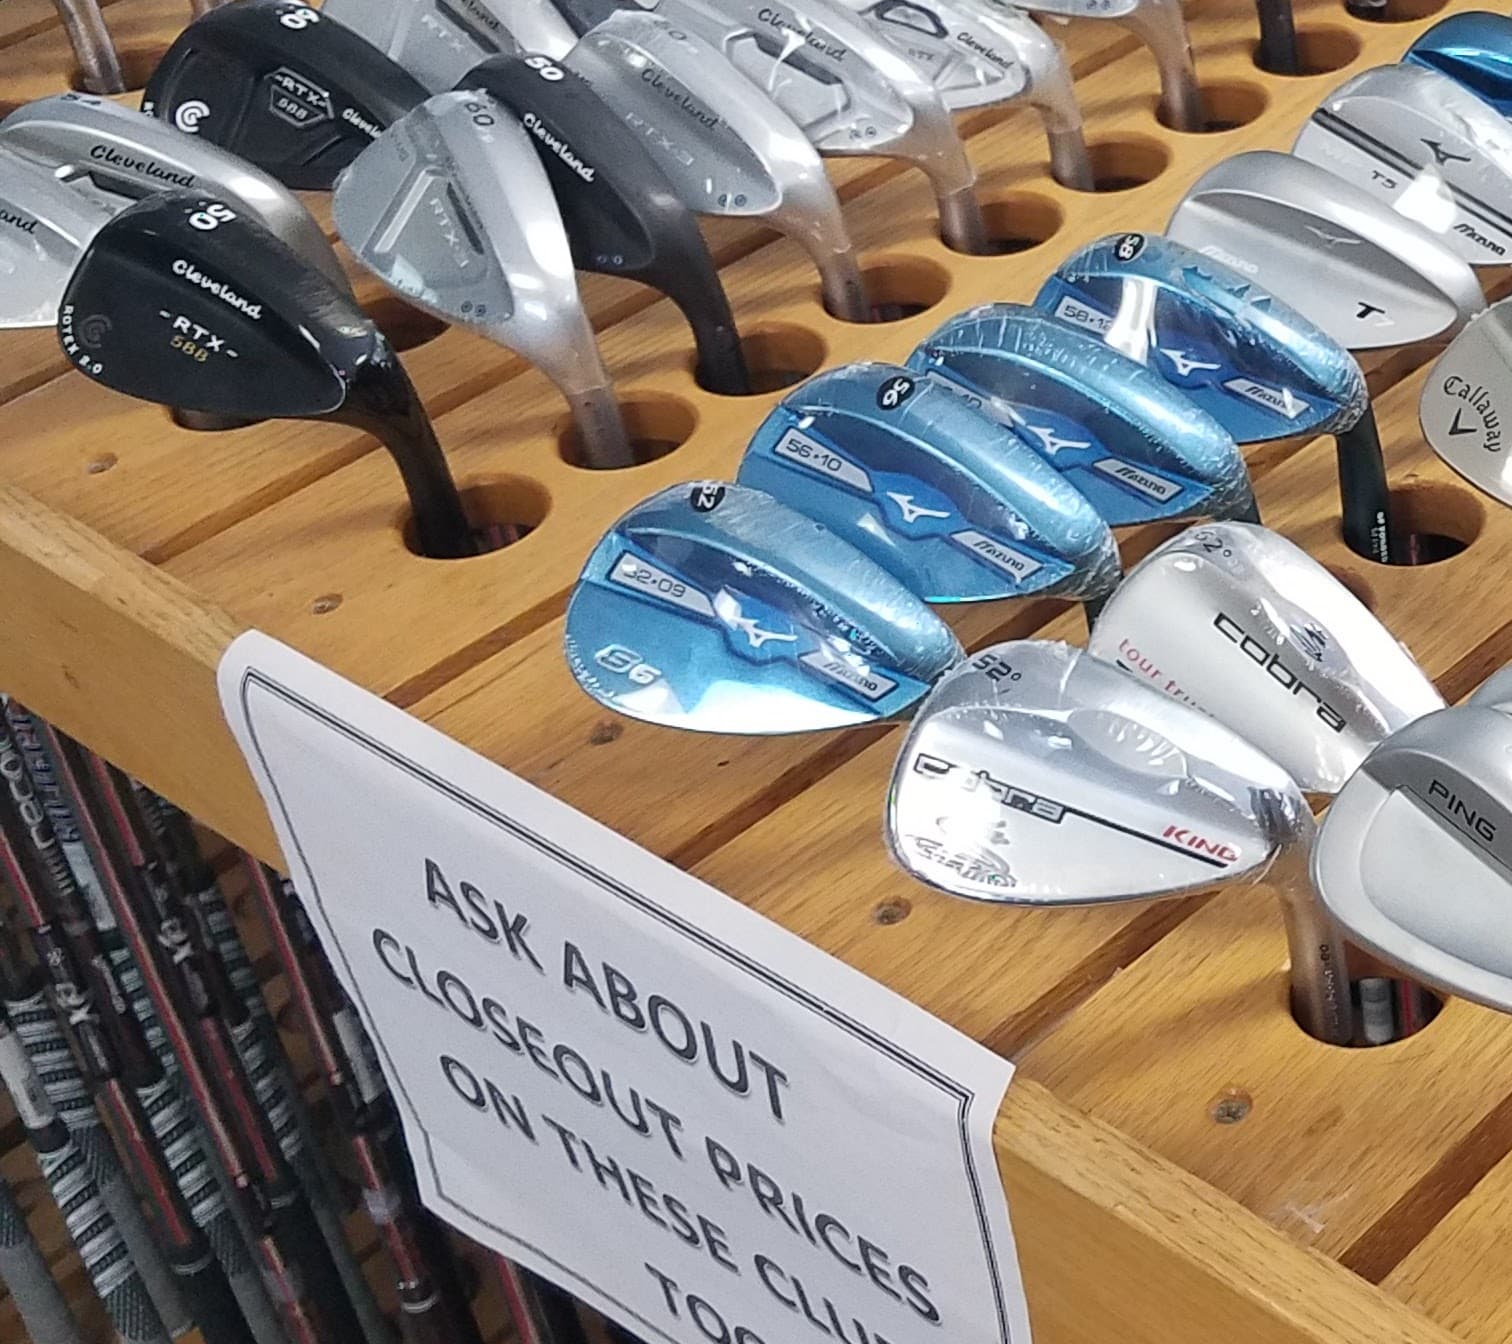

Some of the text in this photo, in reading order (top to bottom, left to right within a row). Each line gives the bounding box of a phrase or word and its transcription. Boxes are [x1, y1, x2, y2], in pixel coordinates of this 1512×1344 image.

[524, 55, 565, 82] 50
[640, 66, 720, 130] Cleveland
[90, 143, 198, 189] Cleveland
[523, 112, 595, 183] Cleveland
[188, 204, 238, 231] 50
[1117, 234, 1143, 261] 58
[172, 259, 263, 320] Cleveland
[60, 304, 80, 356] ROTEX
[169, 334, 209, 363] 588
[882, 378, 911, 407] 56
[1443, 374, 1502, 454] Callaway
[1118, 637, 1164, 680] tour
[1213, 611, 1348, 735] cobra
[1427, 779, 1497, 843] PING
[1161, 824, 1240, 862] KING
[423, 856, 789, 1123] ASK ABOUT
[371, 928, 942, 1326] CLOSEOUT PRICES
[438, 1054, 540, 1146] ON
[540, 1114, 741, 1277] THESE
